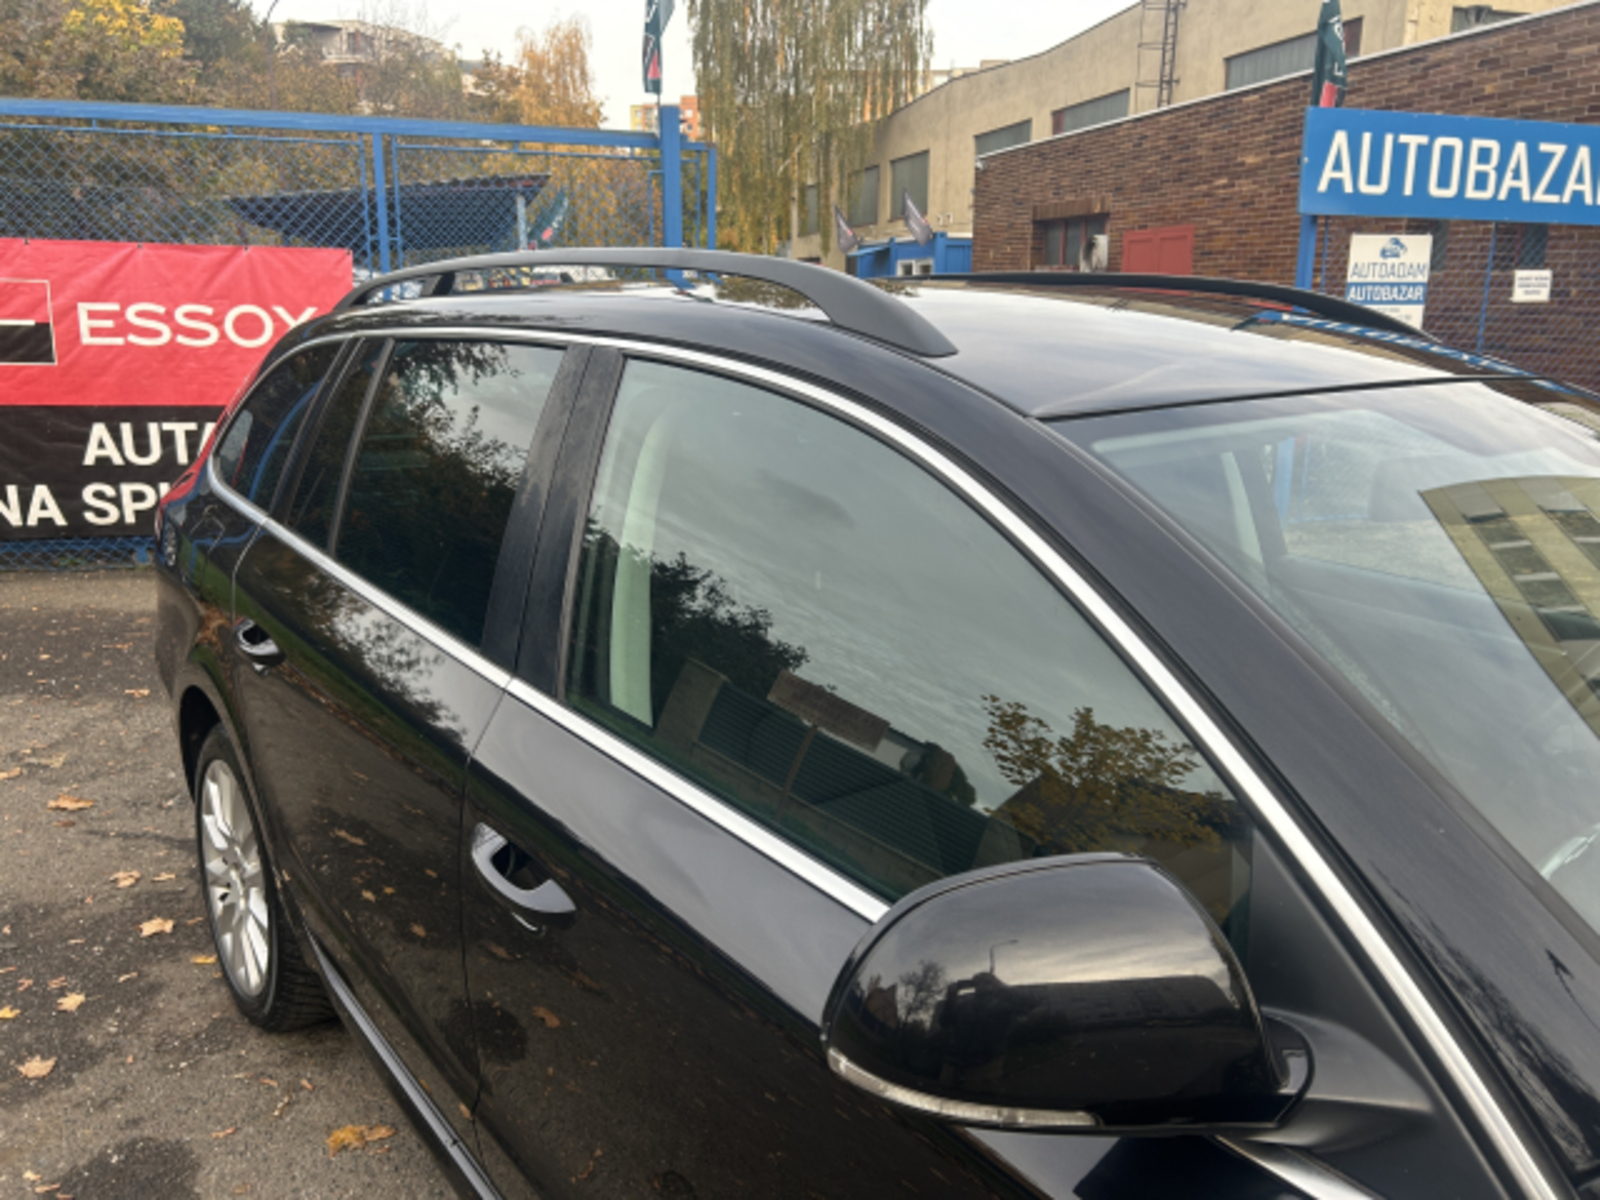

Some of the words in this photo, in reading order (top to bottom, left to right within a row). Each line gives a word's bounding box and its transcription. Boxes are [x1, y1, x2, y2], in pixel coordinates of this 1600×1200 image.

[1316, 130, 1600, 206] AUTOBAZA
[1350, 262, 1426, 279] AUTOADAM
[1347, 285, 1424, 301] AUTOBAZAR
